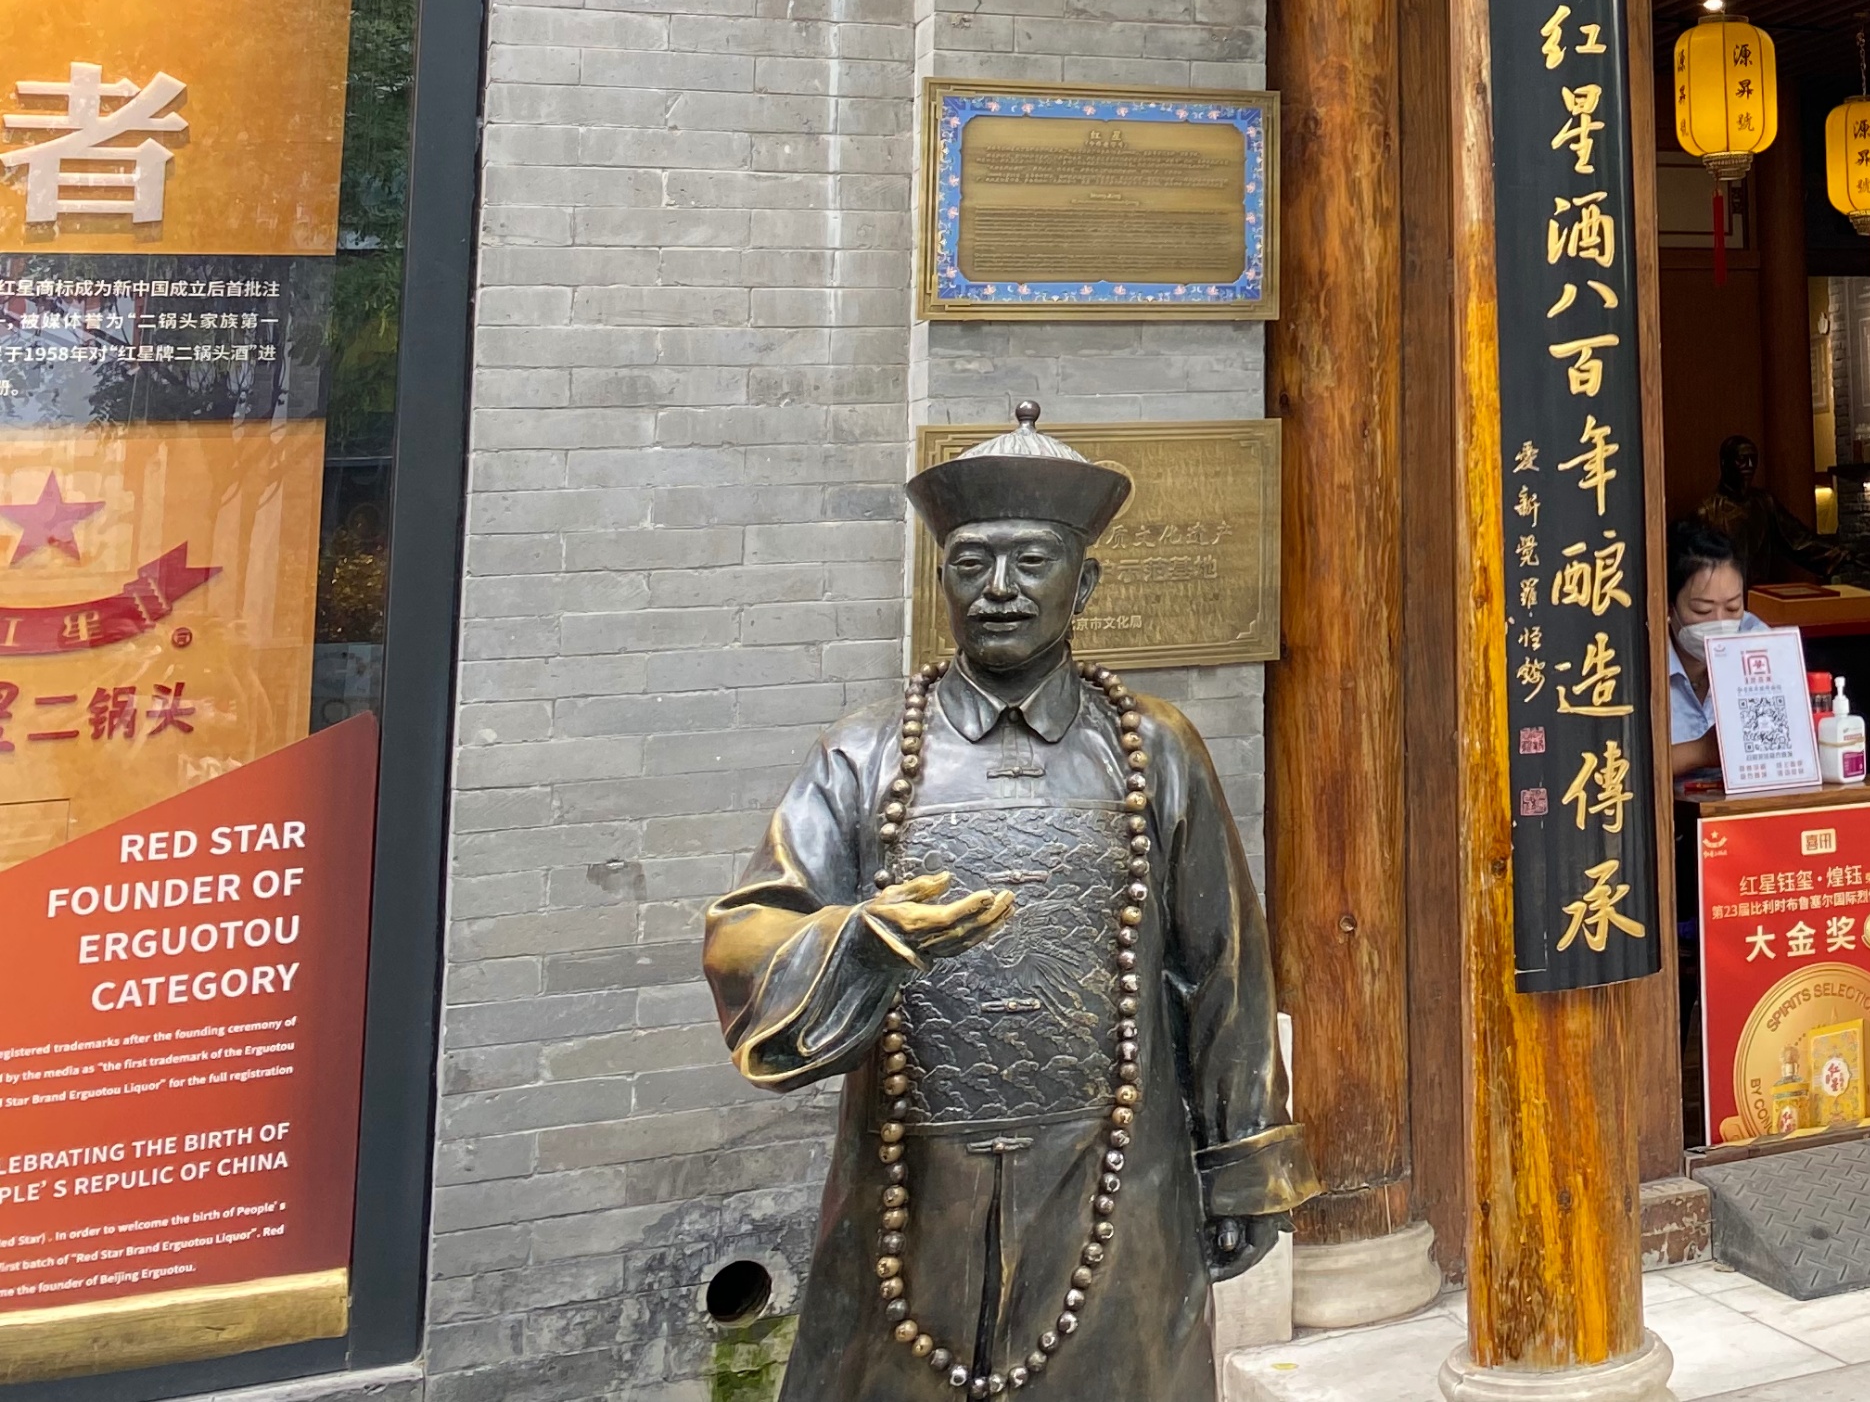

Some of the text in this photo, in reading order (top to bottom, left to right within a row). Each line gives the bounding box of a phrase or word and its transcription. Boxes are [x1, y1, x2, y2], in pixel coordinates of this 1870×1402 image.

[0, 61, 190, 224] 者
[0, 344, 277, 363] 于1958年对“红星牌二锅头酒”进
[121, 821, 305, 862] RED STAR
[48, 868, 303, 918] FOUNDER OF
[79, 915, 300, 964] ERGUOTOU
[1745, 916, 1856, 962] 大金奖
[91, 962, 300, 1011] CATEGORY
[1766, 987, 1811, 1032] SPIRITS
[54, 1038, 120, 1052] trademarks
[123, 1034, 150, 1045] after
[153, 1032, 172, 1041] the
[175, 1026, 225, 1039] founding
[228, 1020, 282, 1033] ceremony
[285, 1016, 296, 1026] of
[6, 1073, 20, 1084] by
[22, 1071, 41, 1080] the
[44, 1066, 79, 1078] media
[82, 1066, 95, 1074] as
[124, 1058, 147, 1069] first
[149, 1051, 208, 1066] trademark
[210, 1048, 223, 1059] of
[224, 1048, 242, 1057] the
[245, 1043, 294, 1056] Erguotou
[5, 1097, 29, 1107] Star
[32, 1091, 66, 1104] Brand
[69, 1087, 121, 1100] Erguotou
[169, 1078, 185, 1087] for
[188, 1076, 206, 1085] the
[209, 1072, 227, 1083] full
[230, 1066, 293, 1081] registration
[1750, 1078, 1763, 1096] BY
[132, 1137, 177, 1158] THE
[185, 1127, 252, 1151] BIRTH
[260, 1123, 289, 1141] OF
[54, 1180, 67, 1197] S
[73, 1166, 174, 1196] REPULIC
[181, 1161, 211, 1180] OF
[217, 1152, 288, 1175] CHINA
[69, 1227, 101, 1239] order
[103, 1226, 115, 1234] to
[118, 1219, 169, 1232] welcome
[171, 1215, 190, 1225] the
[193, 1210, 220, 1222] birth
[223, 1207, 235, 1218] of
[22, 1257, 54, 1269] batch
[57, 1254, 70, 1265] of
[101, 1249, 124, 1259] Star
[126, 1242, 160, 1256] Brand
[162, 1237, 213, 1252] Erguotou
[263, 1224, 284, 1236] Red
[17, 1285, 36, 1295] the
[38, 1279, 84, 1292] founder
[86, 1275, 99, 1286] of
[100, 1272, 139, 1284] Beijing
